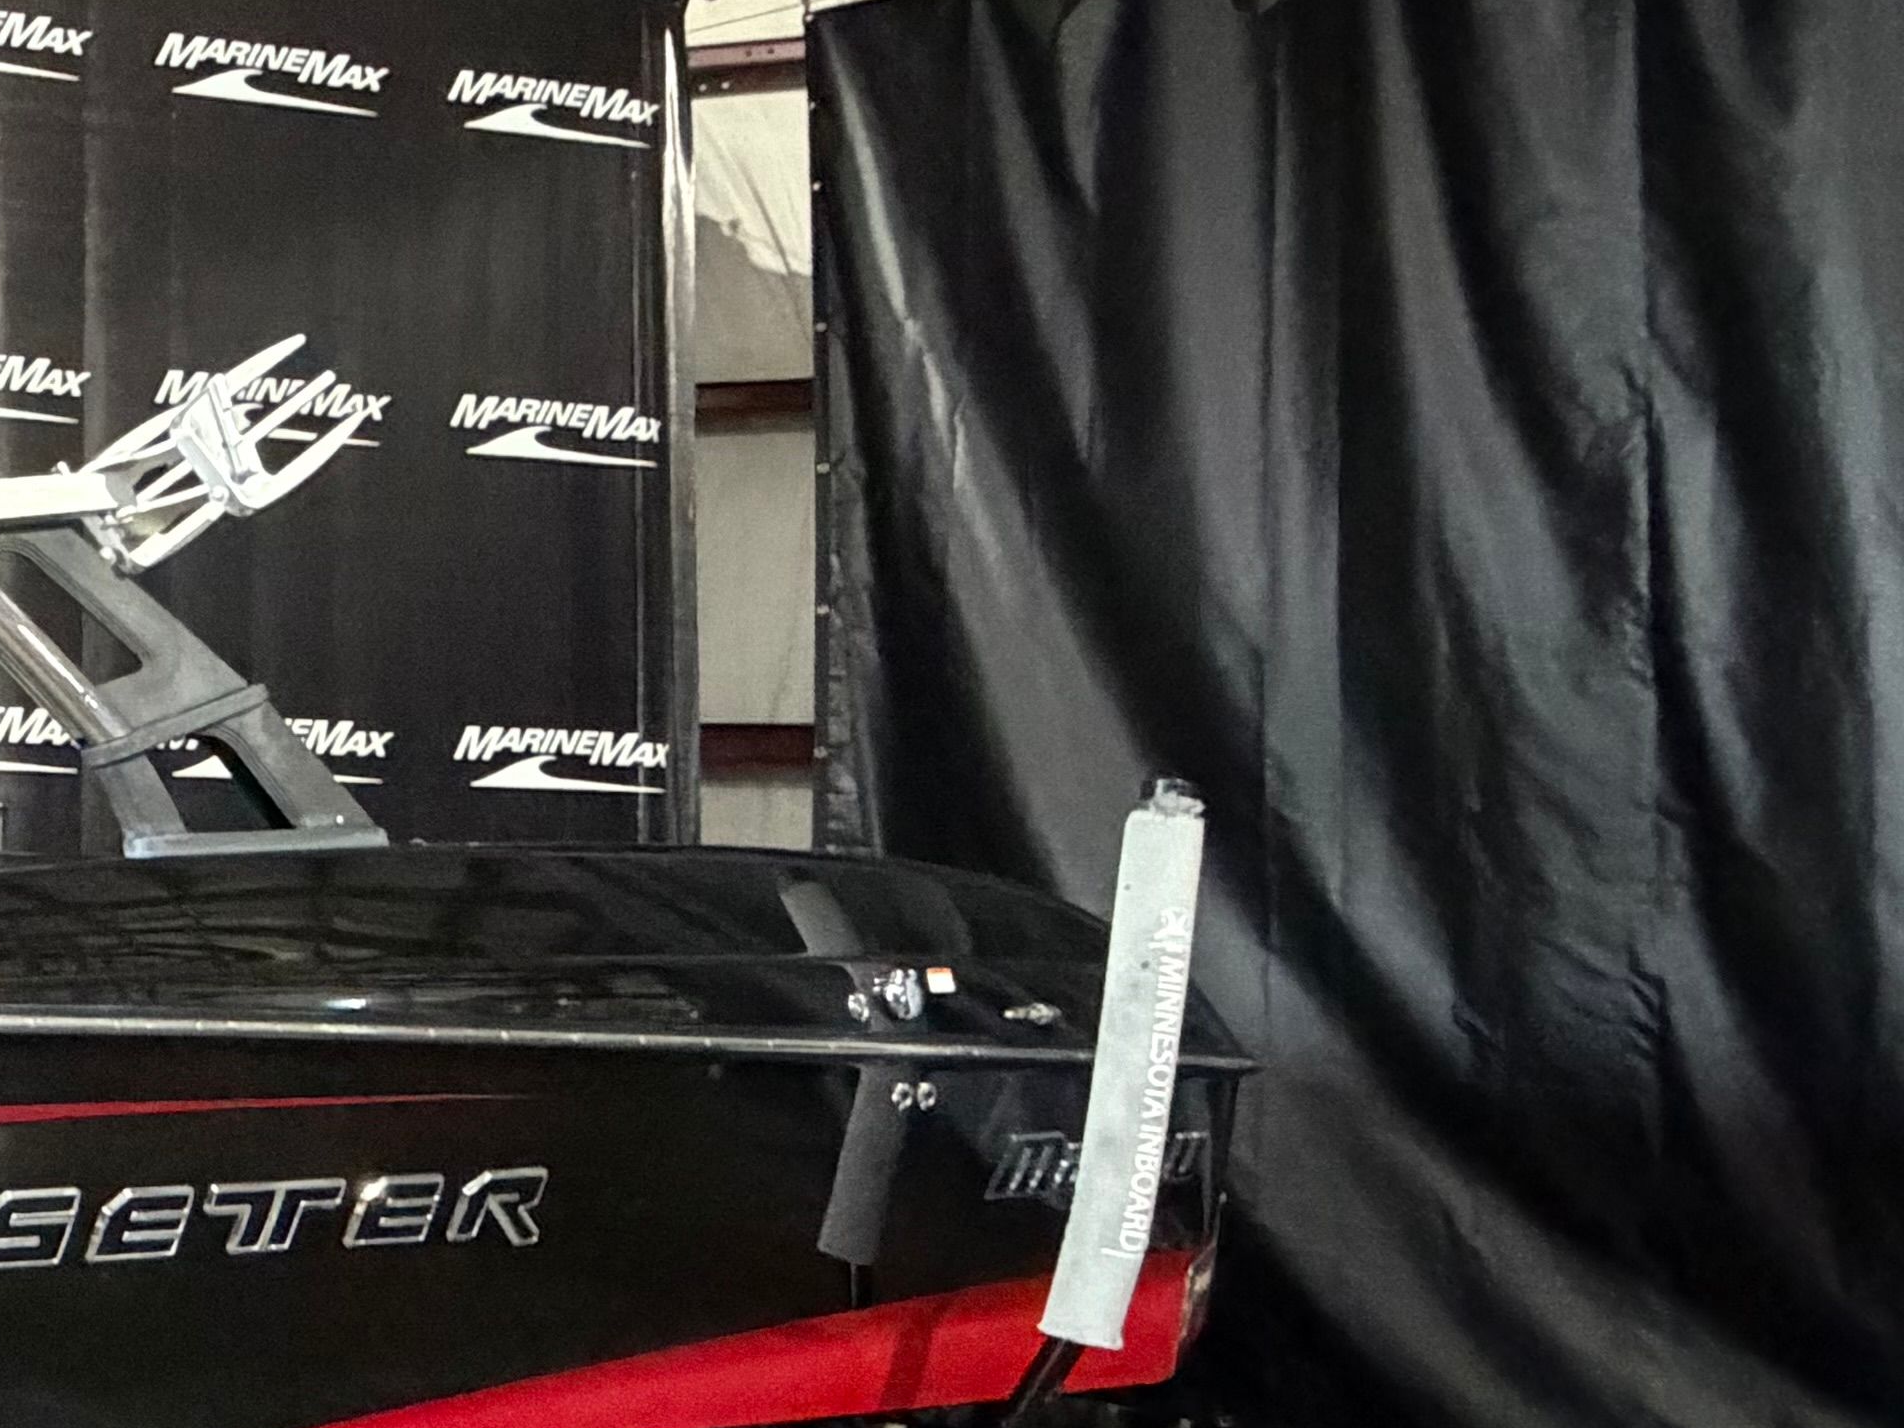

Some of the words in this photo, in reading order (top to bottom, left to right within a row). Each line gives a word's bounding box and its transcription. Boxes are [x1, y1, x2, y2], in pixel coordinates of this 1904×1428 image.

[153, 32, 389, 93] MARINEMAX
[446, 69, 659, 127] MARINEMAX
[449, 393, 663, 444] MARINEMAX
[453, 724, 670, 769] MARINEMAX
[1140, 955, 1185, 1120] MINNESOTA
[1118, 1124, 1164, 1254] INBOARD
